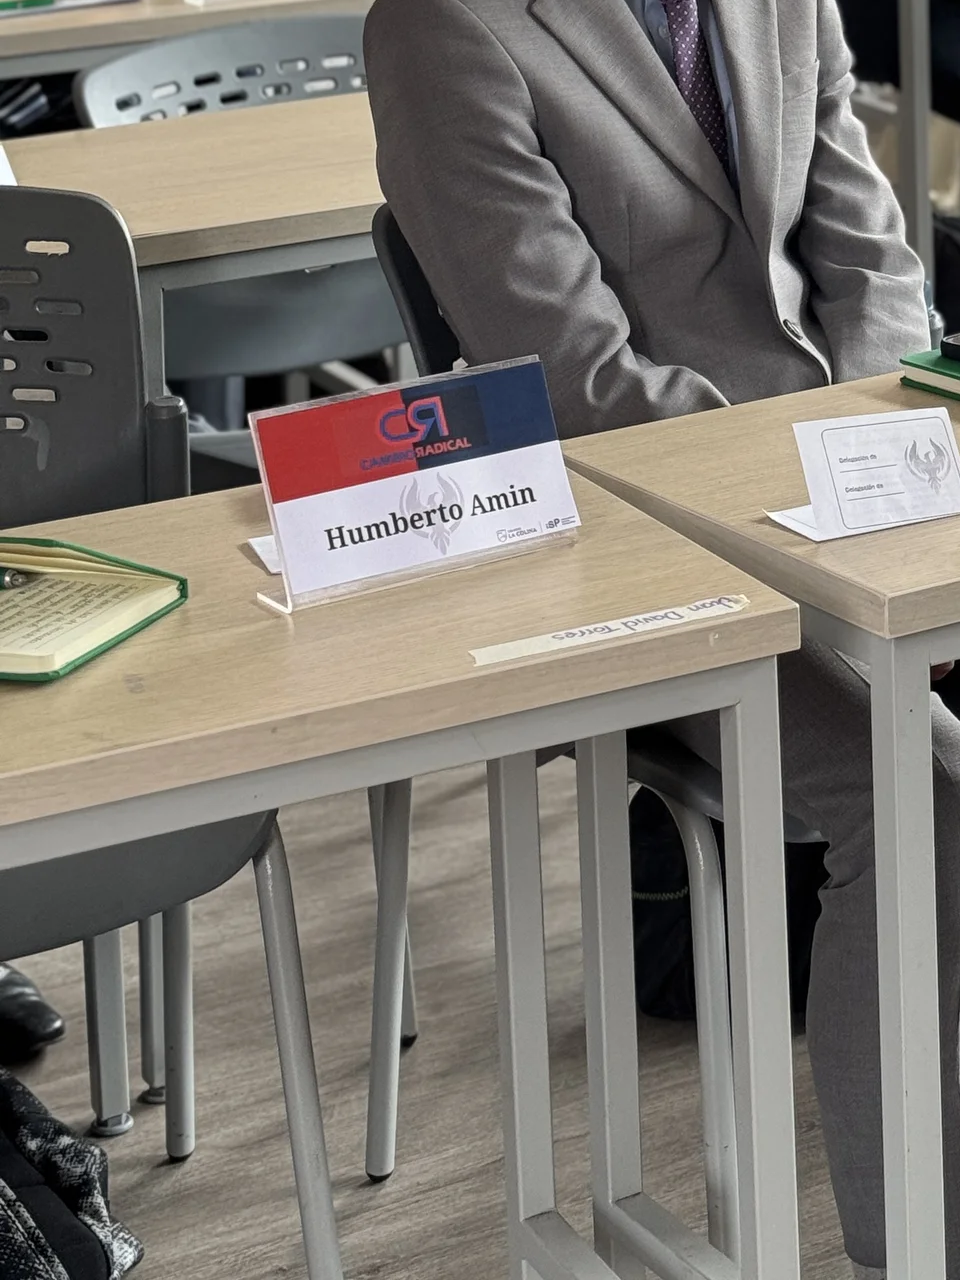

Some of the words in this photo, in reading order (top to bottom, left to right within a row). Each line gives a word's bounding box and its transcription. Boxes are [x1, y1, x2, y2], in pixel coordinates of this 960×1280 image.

[415, 437, 472, 458] RADICAL
[324, 503, 463, 551] Humberto
[470, 484, 537, 517] Amin
[621, 611, 684, 631] David
[551, 624, 620, 641] Torres
